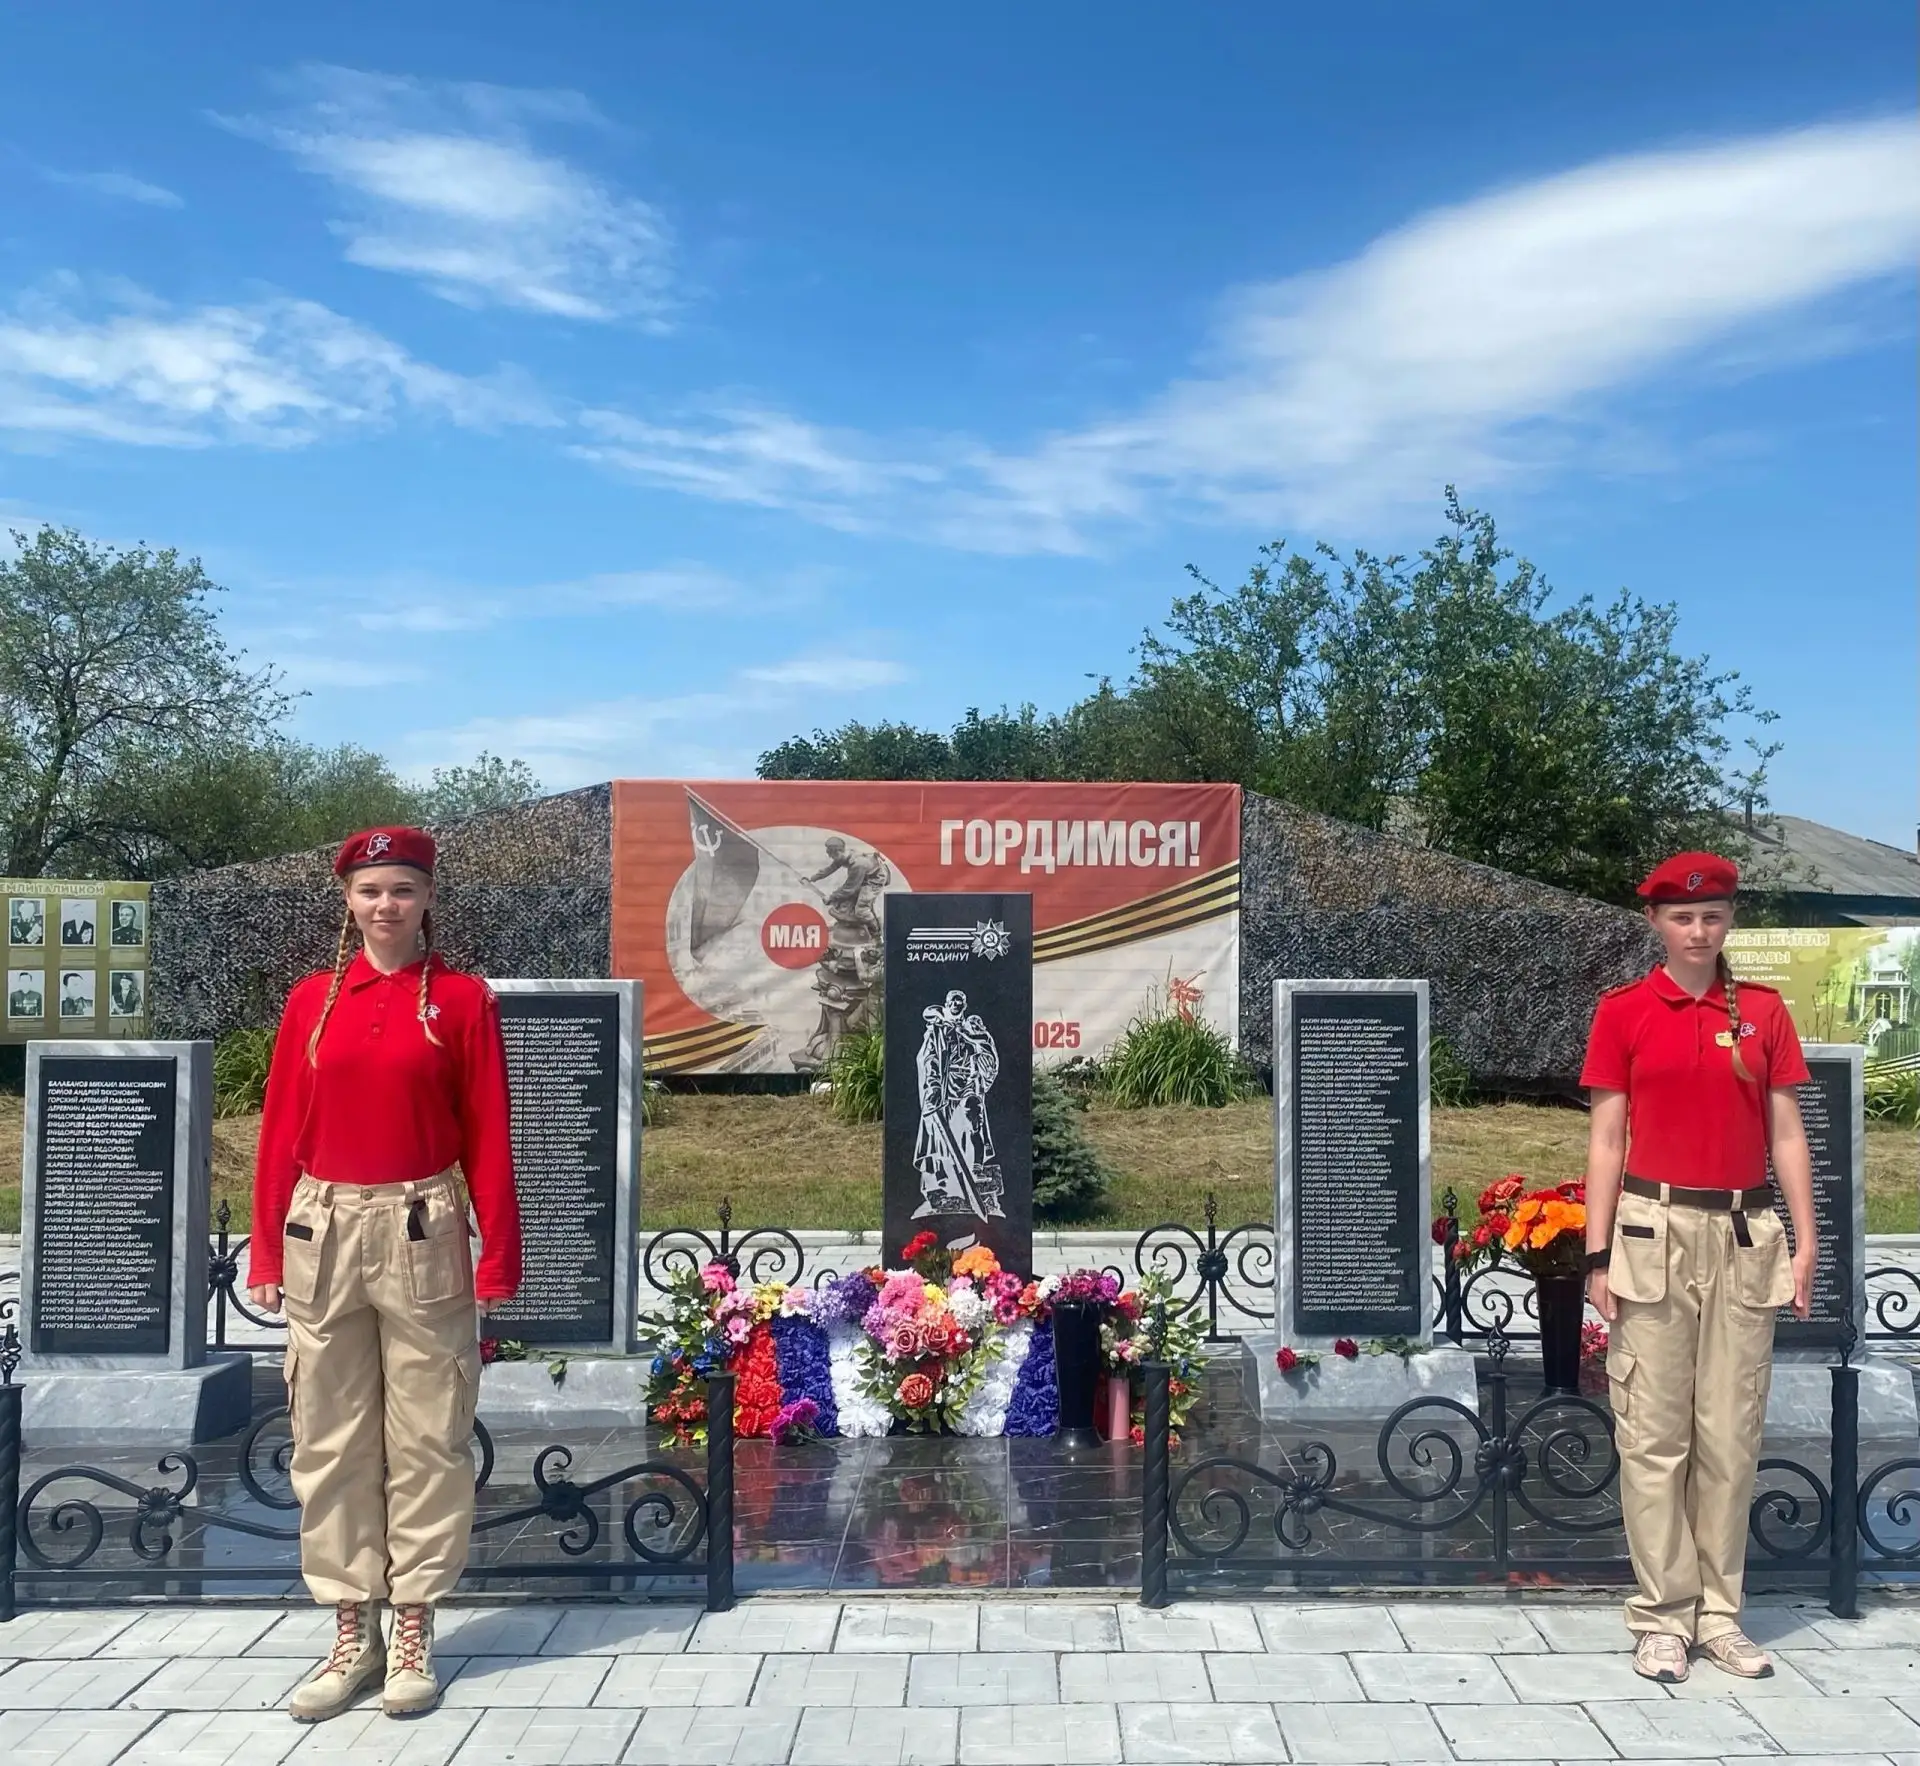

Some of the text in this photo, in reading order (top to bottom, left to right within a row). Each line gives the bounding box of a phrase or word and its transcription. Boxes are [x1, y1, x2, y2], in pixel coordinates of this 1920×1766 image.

[940, 819, 1201, 874] ГОРДИМСЯ!
[36, 882, 105, 896] ТАЛИЦКОЙ
[769, 924, 821, 948] МАЯ
[1768, 933, 1831, 947] ЖИТЕЛИ
[906, 952, 920, 962] ЗА
[1729, 951, 1791, 964] УПРАВЫ
[1034, 1021, 1081, 1049] 025
